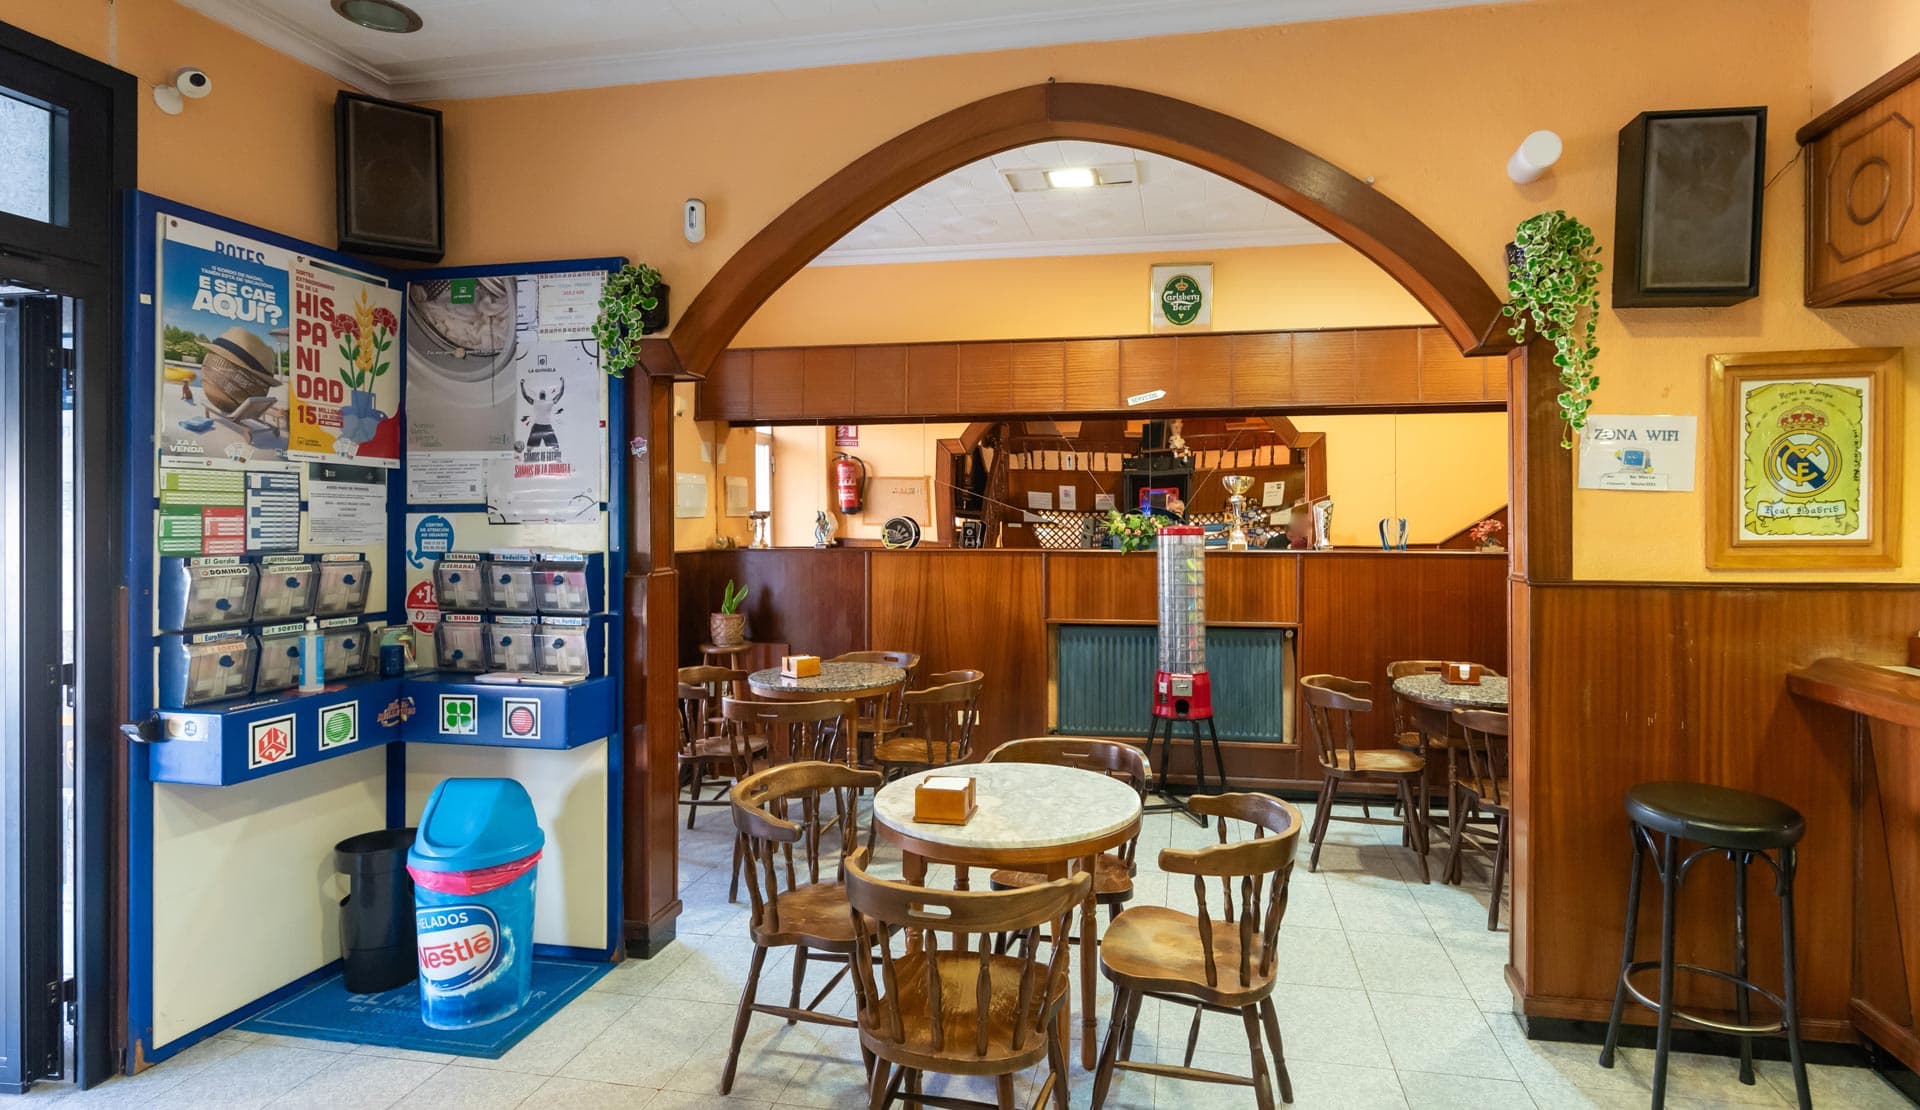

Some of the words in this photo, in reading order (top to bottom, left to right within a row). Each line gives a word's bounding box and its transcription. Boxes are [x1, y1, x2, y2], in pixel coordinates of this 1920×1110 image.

[215, 240, 265, 265] BOTES
[199, 275, 211, 289] E
[214, 279, 238, 295] SE
[240, 285, 276, 304] CAE
[1163, 290, 1200, 304] Carlsberg
[191, 288, 283, 325] AQUÍ?
[296, 289, 336, 321] HIS
[1171, 302, 1192, 311] Beer
[297, 318, 327, 347] PA
[297, 345, 320, 373] NI
[297, 374, 344, 404] DAD
[297, 404, 317, 425] 15
[1594, 428, 1638, 440] ZONA
[1646, 429, 1680, 442] WIFI
[169, 445, 204, 453] VENDA
[1765, 505, 1790, 515] Real
[1796, 505, 1840, 515] Madrid
[278, 624, 303, 632] SORTEO
[217, 643, 246, 653] SORTEO
[261, 735, 271, 749] 1
[276, 731, 287, 746] X
[419, 931, 491, 969] Nestlé
